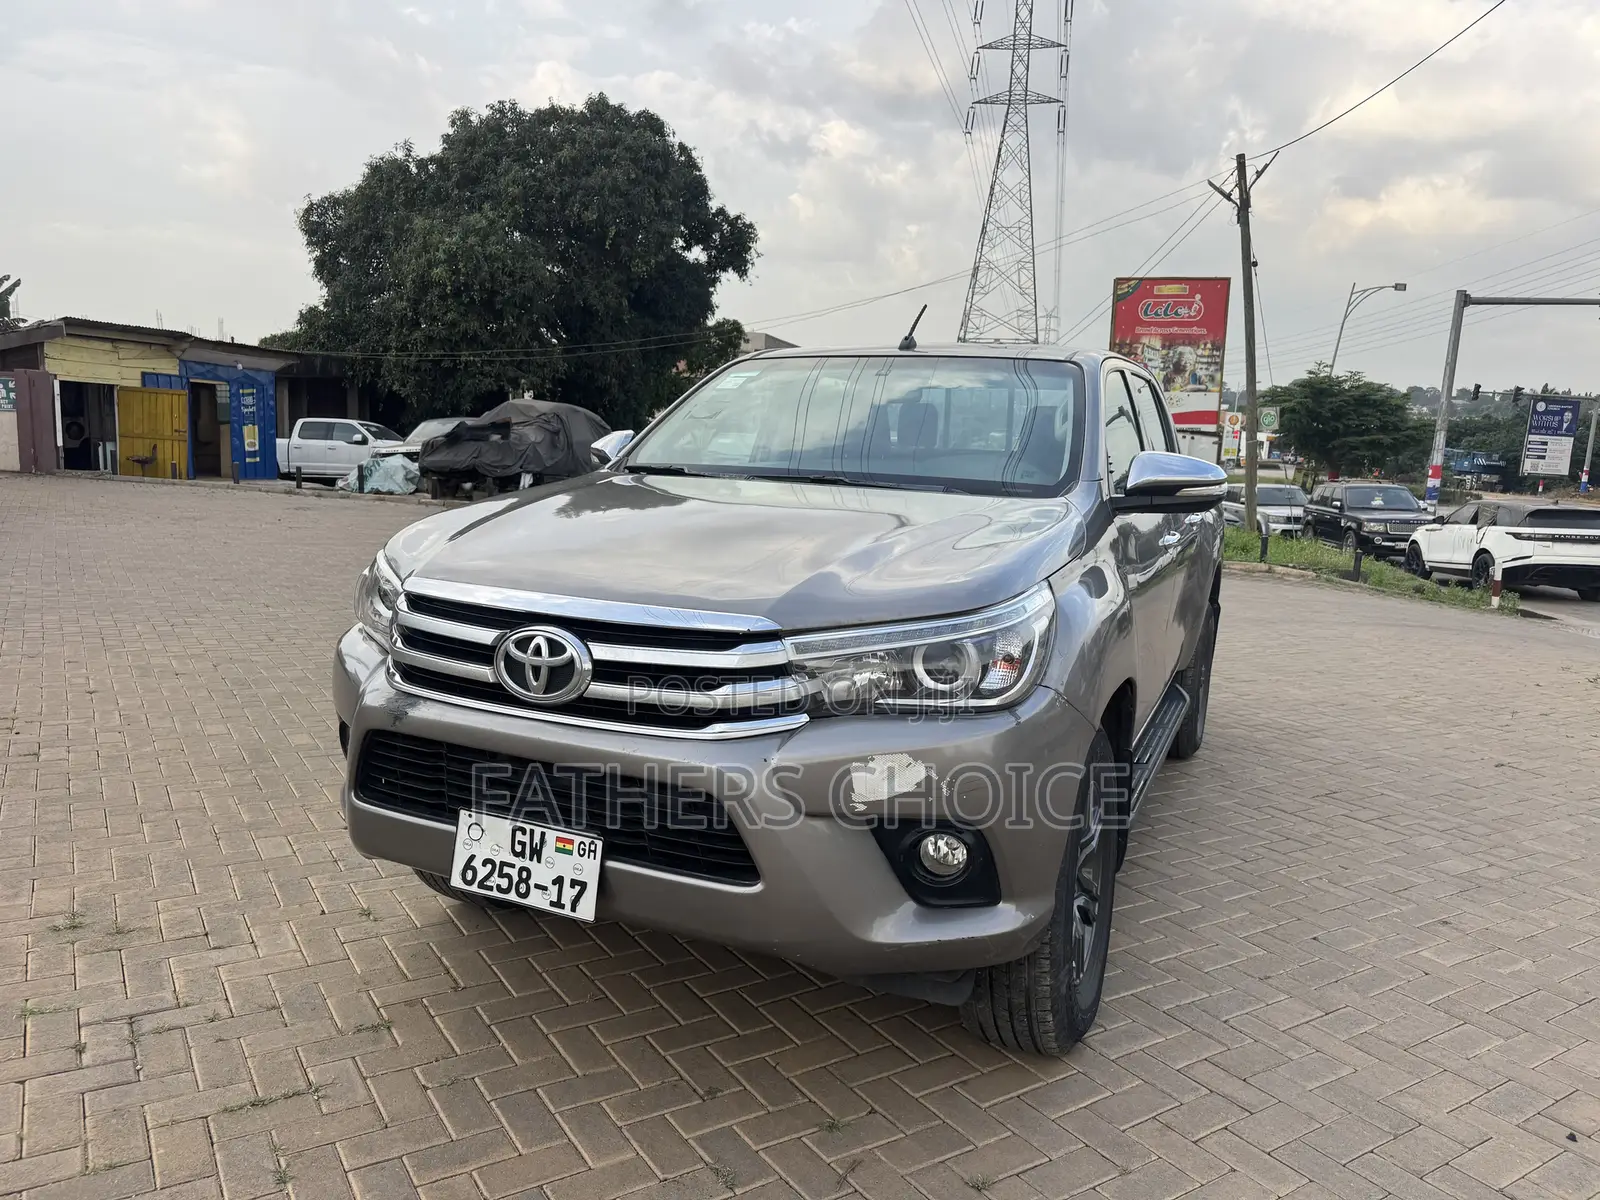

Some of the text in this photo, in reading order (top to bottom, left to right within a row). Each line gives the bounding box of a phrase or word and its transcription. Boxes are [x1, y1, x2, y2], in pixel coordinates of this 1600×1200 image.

[510, 825, 547, 864] GW
[577, 840, 598, 861] GA
[460, 853, 588, 913] 6258-17
